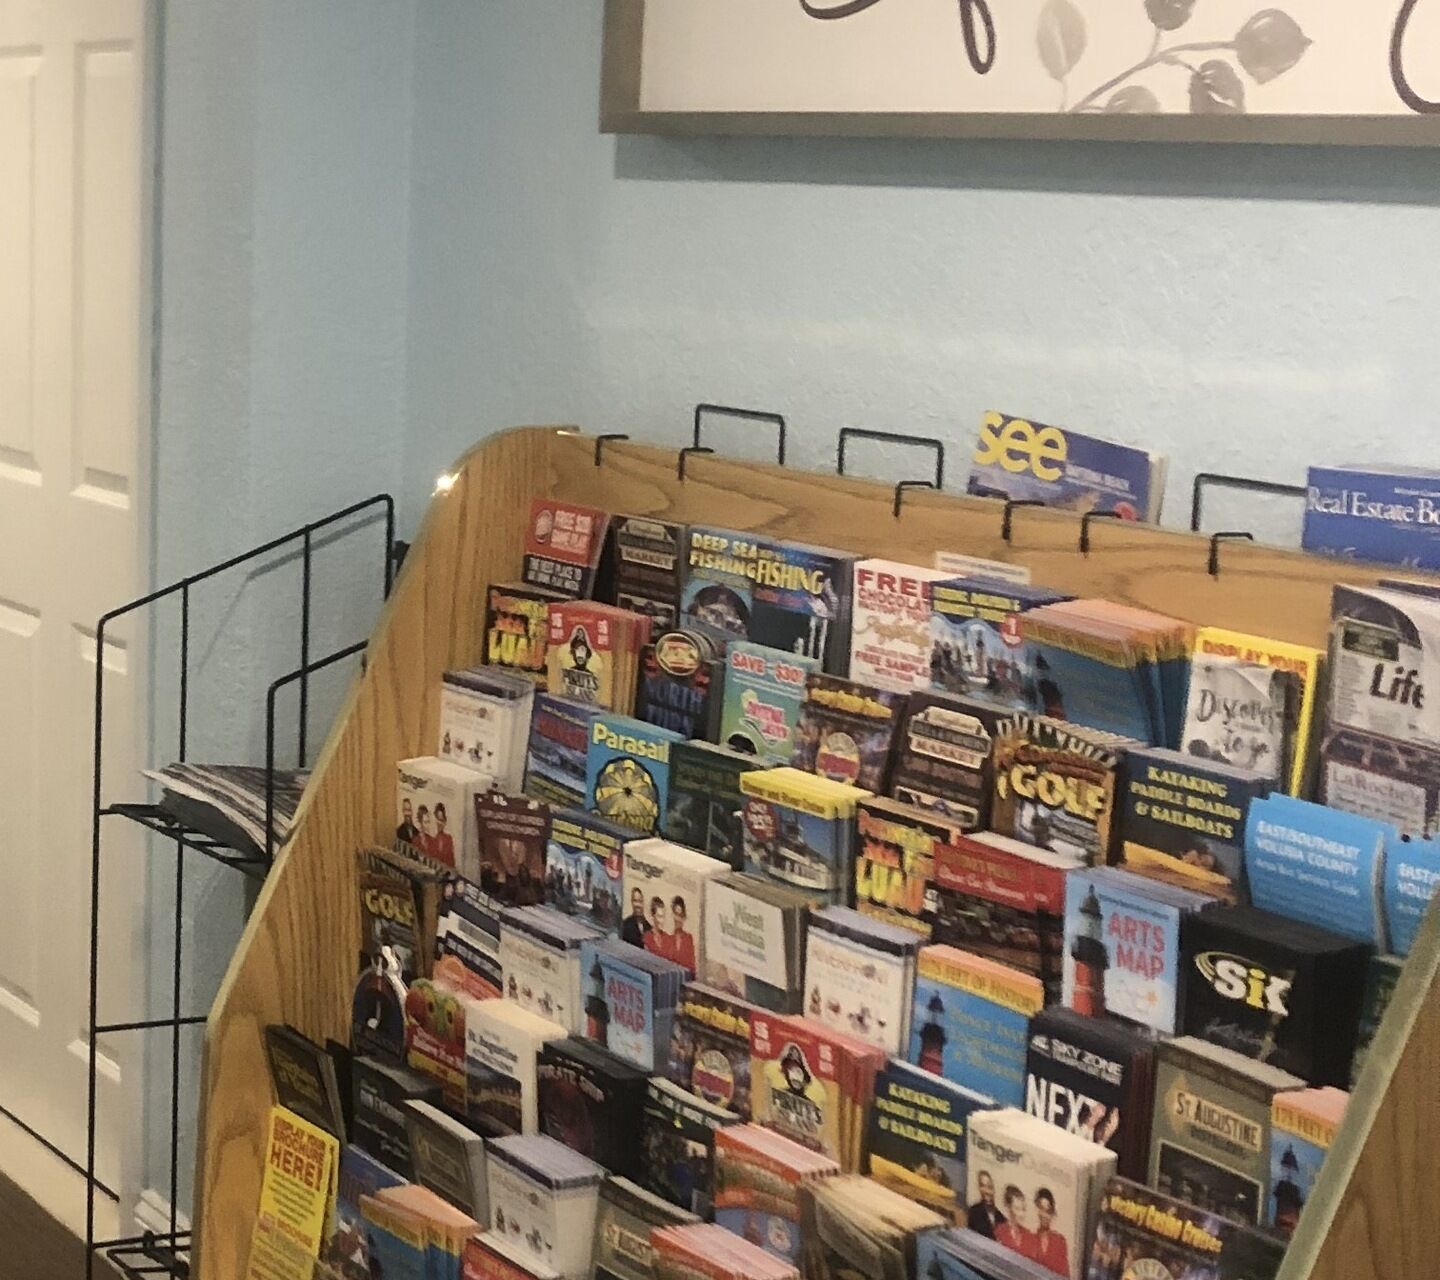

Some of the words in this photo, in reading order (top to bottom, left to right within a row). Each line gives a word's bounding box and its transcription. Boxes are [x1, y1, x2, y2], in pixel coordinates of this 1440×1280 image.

[972, 410, 1068, 482] see
[1306, 486, 1348, 515] Real
[1352, 491, 1414, 522] Estate
[691, 532, 728, 552] DEEP
[732, 540, 757, 559] SEA
[690, 550, 757, 579] FISHING
[756, 558, 824, 596] FISHING
[858, 588, 931, 613] CHOCOLAT
[592, 722, 670, 763] Parasail
[1011, 764, 1106, 820] GOLF
[1129, 781, 1183, 806] PADDLE
[1147, 765, 1228, 798] KAYAKING
[1151, 804, 1234, 839] SAILBOATS
[626, 853, 664, 879] Tanger
[1108, 912, 1165, 954] ARTS
[1116, 942, 1165, 982] MAP
[970, 1128, 1024, 1164] Tanger
[270, 1142, 324, 1193] HERE!
